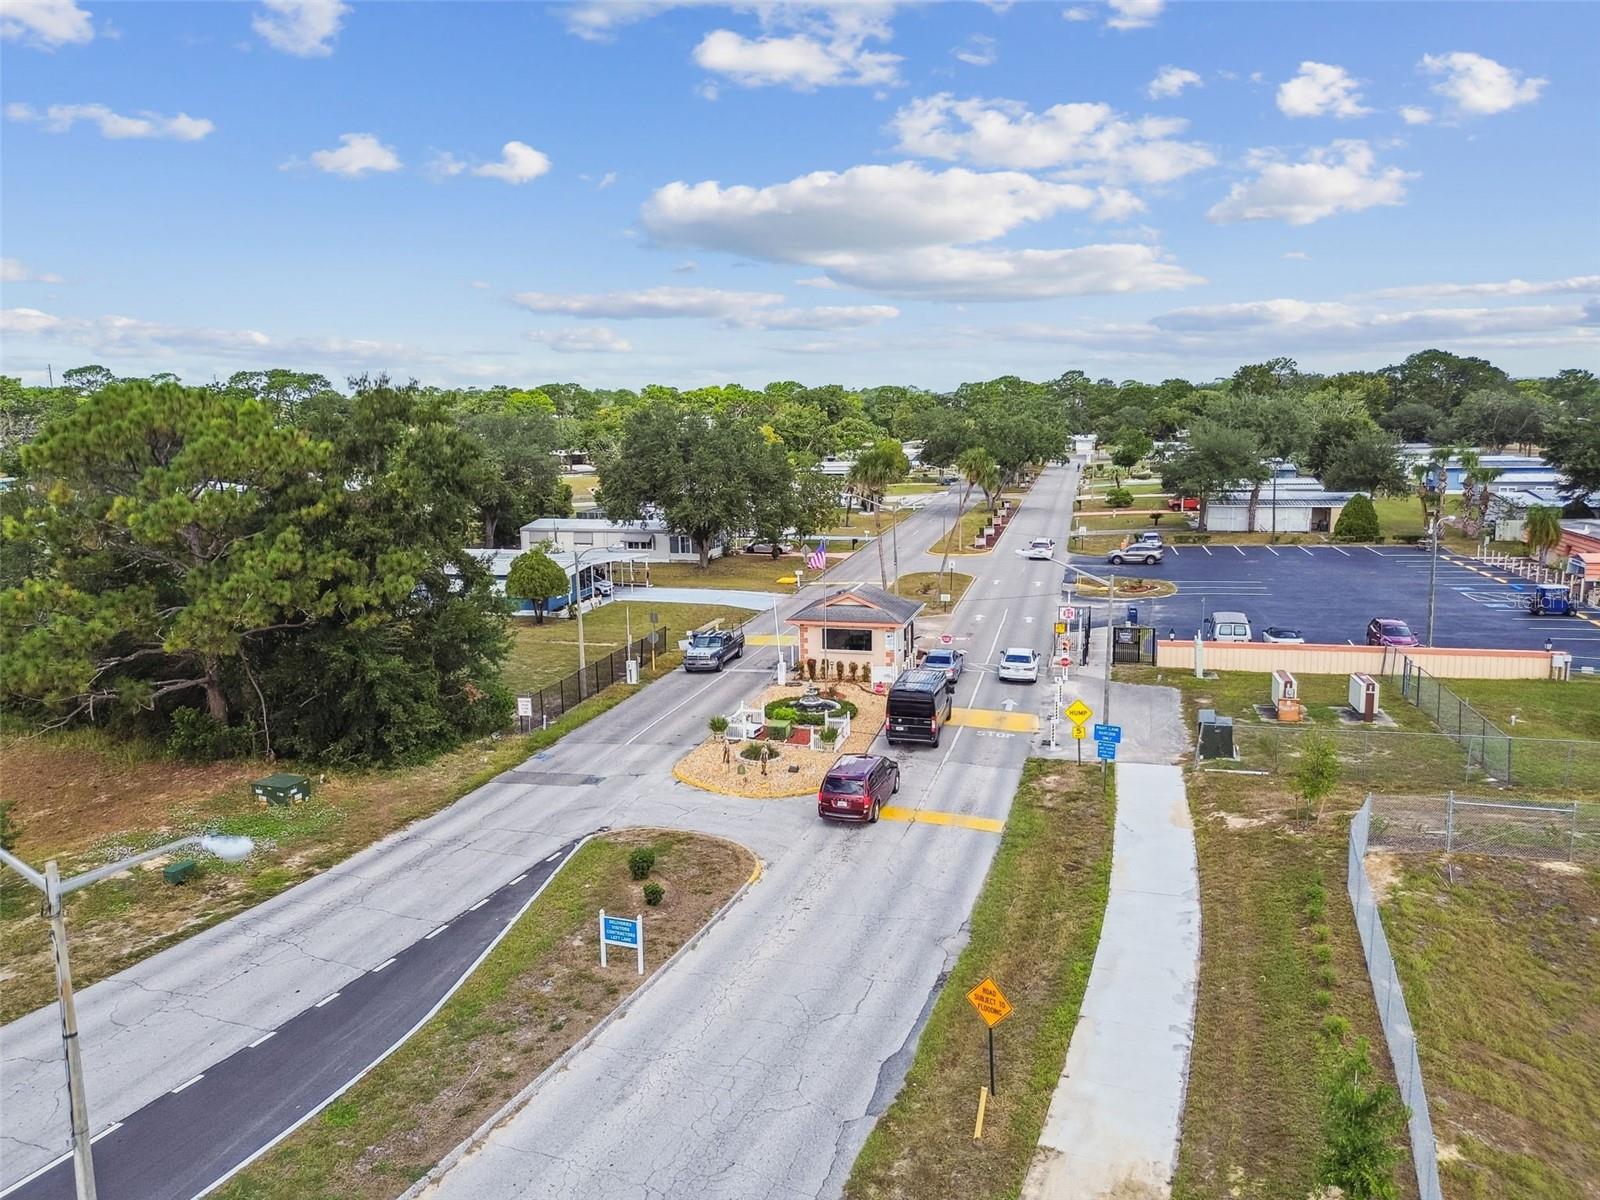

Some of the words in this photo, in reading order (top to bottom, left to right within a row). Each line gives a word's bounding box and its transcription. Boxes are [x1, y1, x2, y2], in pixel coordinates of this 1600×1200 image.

[976, 730, 1016, 739] STOP
[606, 929, 636, 938] CONTRACTORS
[982, 987, 997, 998] ROAD
[974, 993, 996, 1006] SUBJECT
[999, 1000, 1006, 1009] TO
[977, 1002, 1002, 1017] FLOODING
